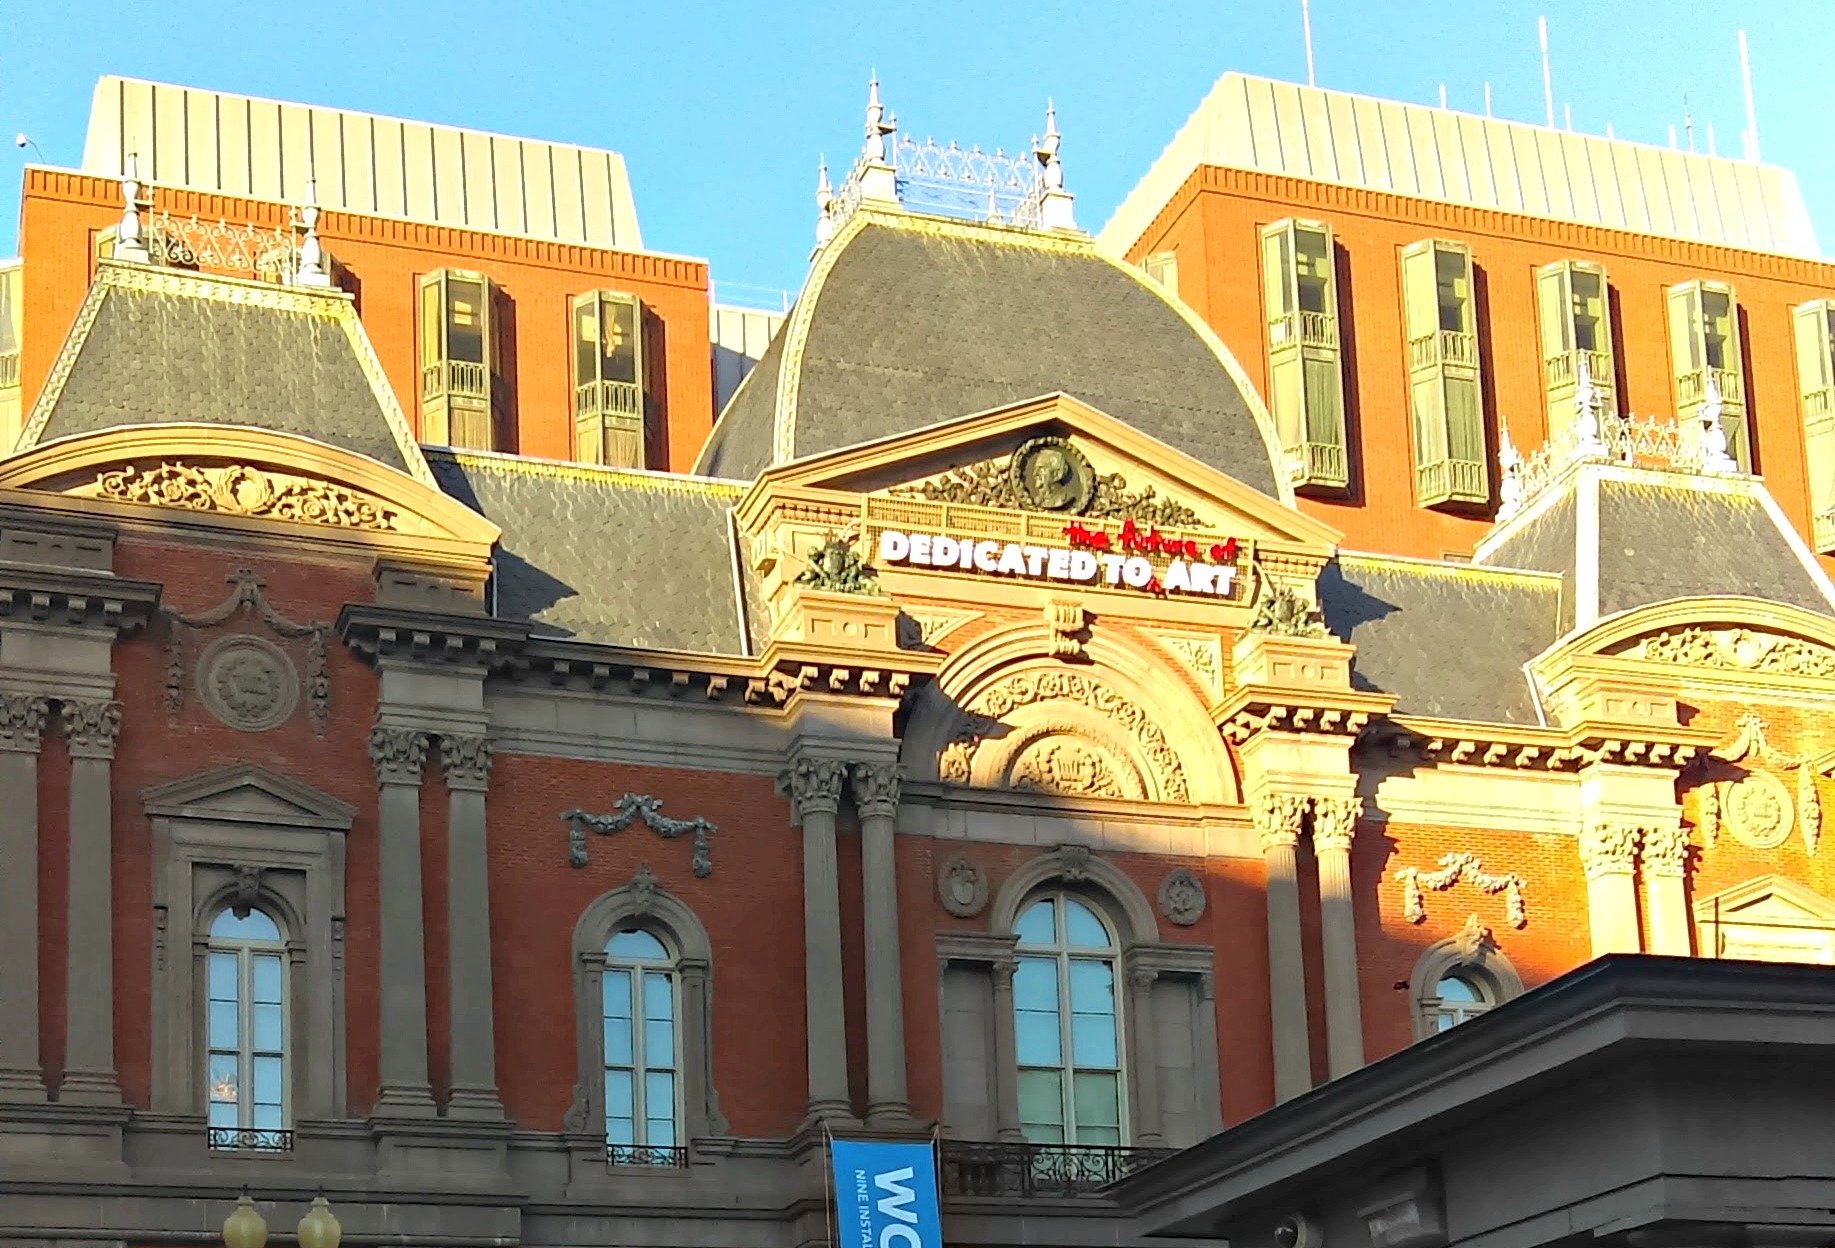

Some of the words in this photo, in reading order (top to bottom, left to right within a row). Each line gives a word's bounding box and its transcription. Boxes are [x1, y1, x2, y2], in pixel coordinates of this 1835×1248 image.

[880, 531, 1098, 580] DEDICATED
[1102, 553, 1152, 587] TO
[1162, 557, 1236, 595] ART
[855, 1169, 869, 1202] NINE
